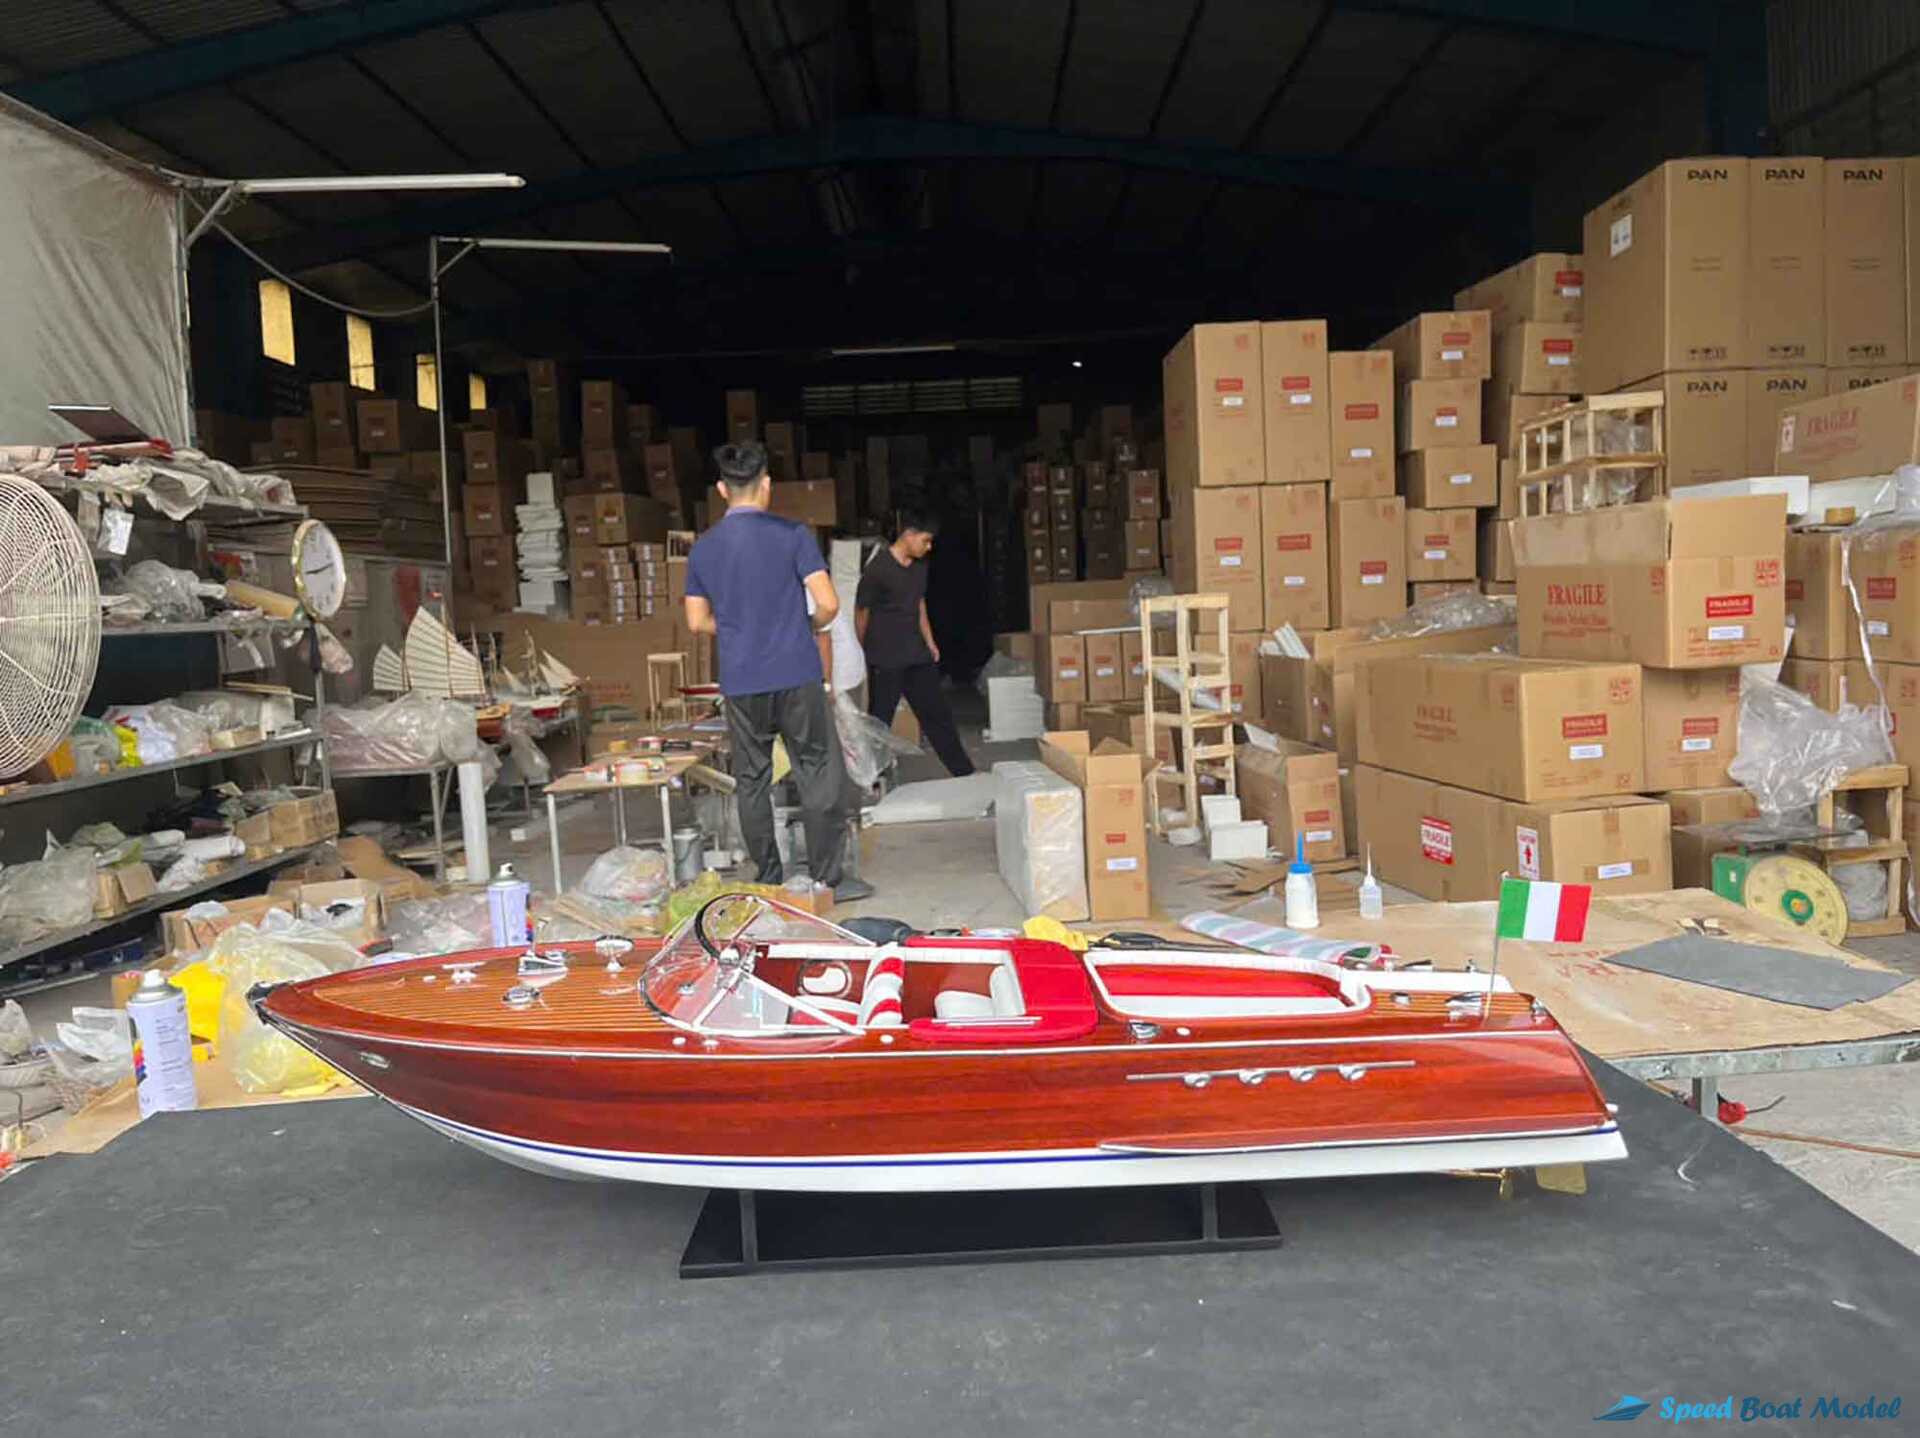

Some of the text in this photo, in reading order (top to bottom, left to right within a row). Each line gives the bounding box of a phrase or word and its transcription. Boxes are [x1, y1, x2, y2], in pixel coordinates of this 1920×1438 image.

[1687, 169, 1728, 181] PAN
[1765, 168, 1805, 180] PAN
[1843, 168, 1883, 181] PAN
[1687, 380, 1728, 392] PAN
[1766, 379, 1807, 391] PAN
[1547, 583, 1606, 606] FRAGILE
